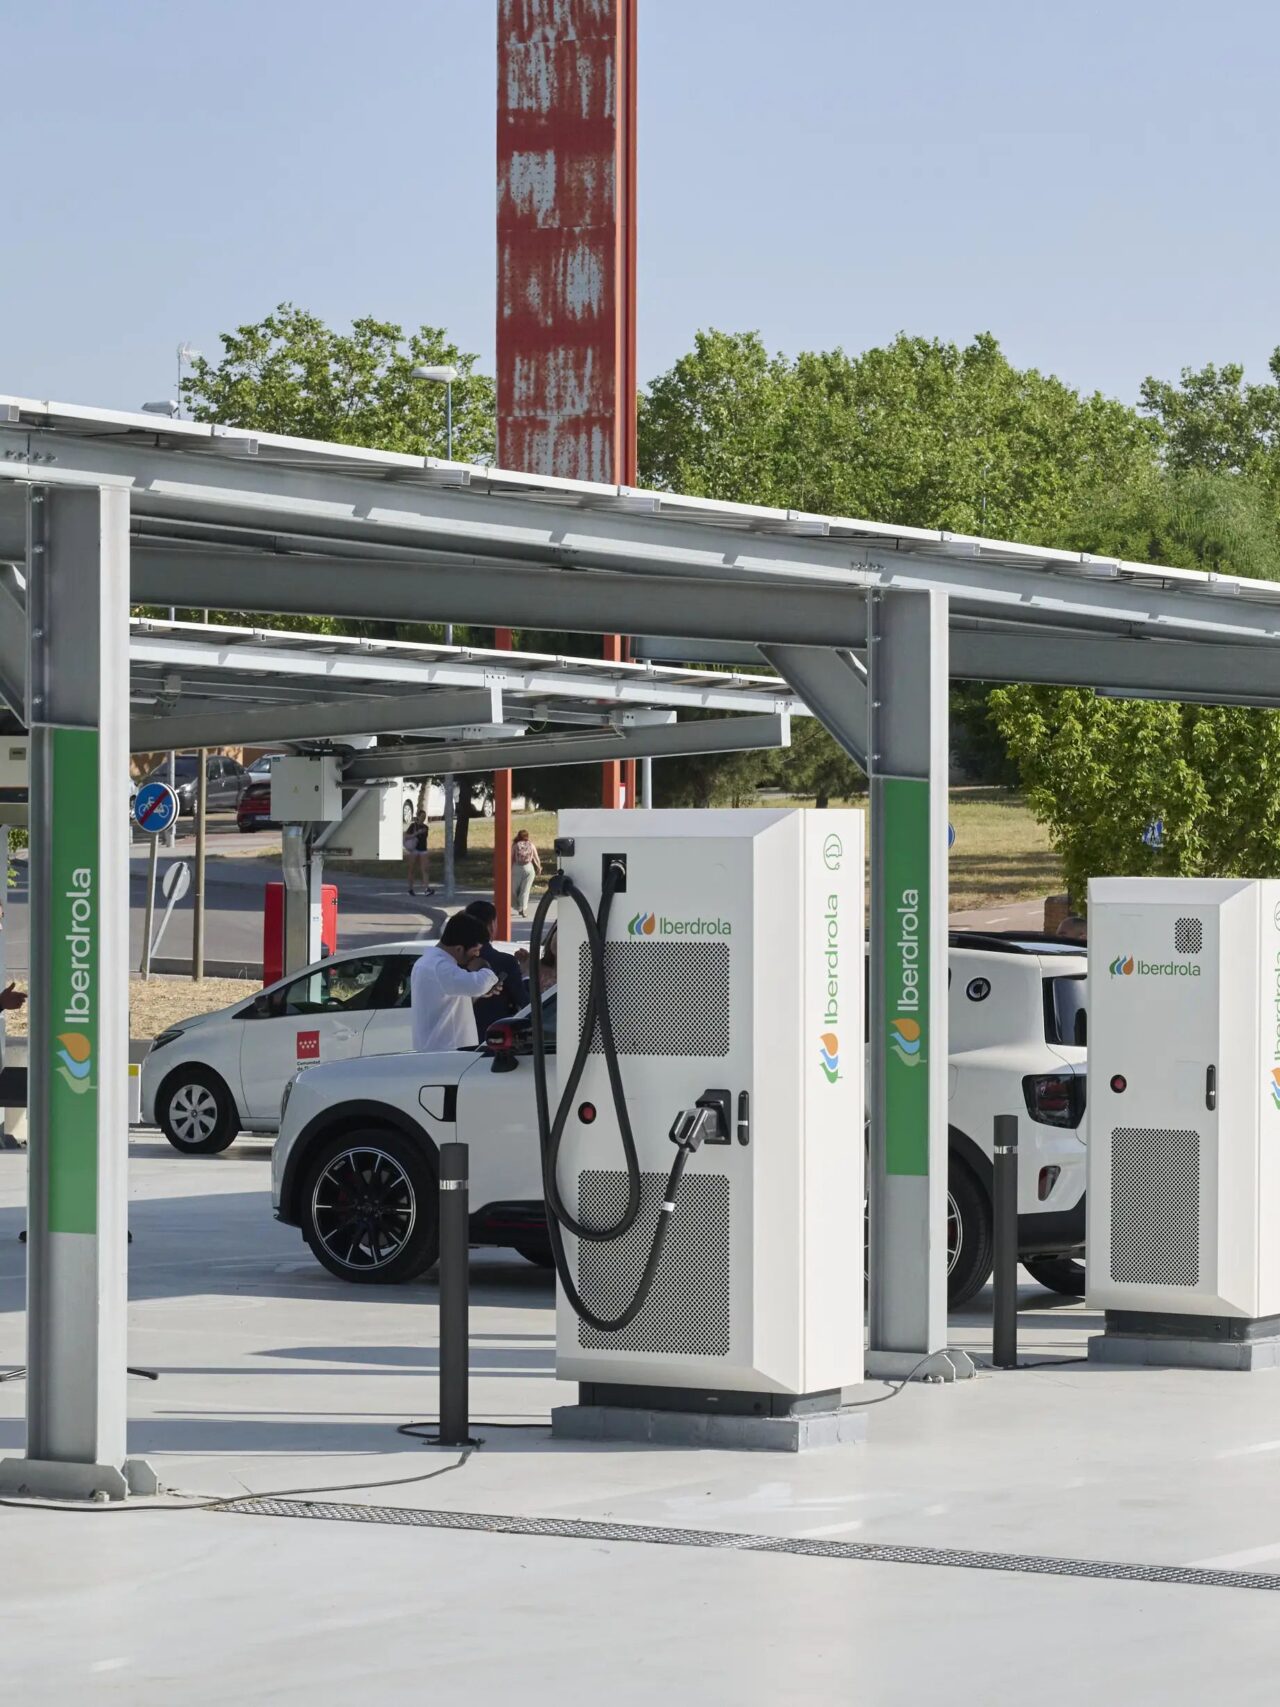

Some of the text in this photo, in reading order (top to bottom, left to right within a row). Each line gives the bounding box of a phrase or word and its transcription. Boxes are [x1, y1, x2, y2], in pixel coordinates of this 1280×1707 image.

[65, 868, 91, 1023] Iberdrola
[660, 918, 731, 935] Iberdrola
[824, 894, 838, 1025] Iberdrola
[897, 889, 919, 1011] Iberdrola
[1137, 961, 1200, 976] Iberdrola
